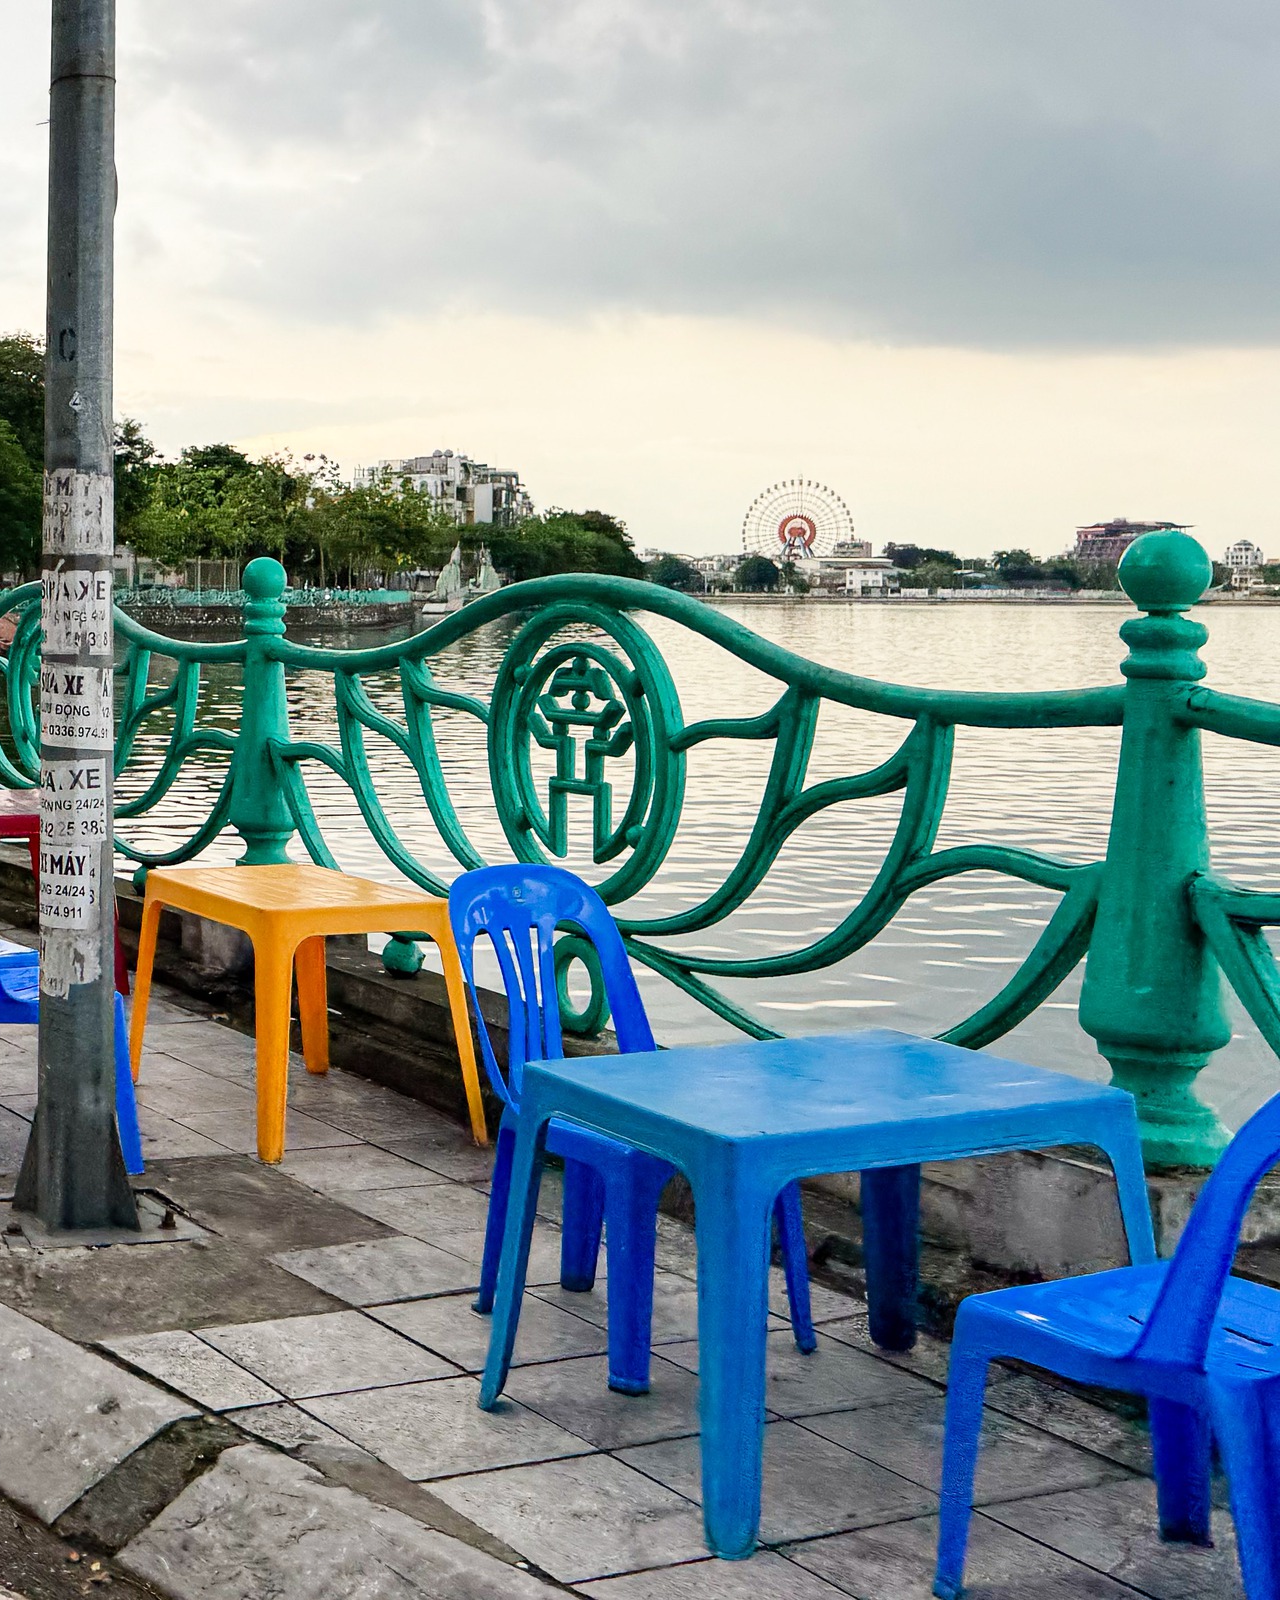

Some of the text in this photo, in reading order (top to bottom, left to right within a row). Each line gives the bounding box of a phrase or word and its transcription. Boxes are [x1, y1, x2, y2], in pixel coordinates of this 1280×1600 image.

[64, 674, 84, 695] XE
[69, 768, 100, 790] XE
[50, 851, 86, 876] MÁY
[55, 884, 85, 897] 24/24
